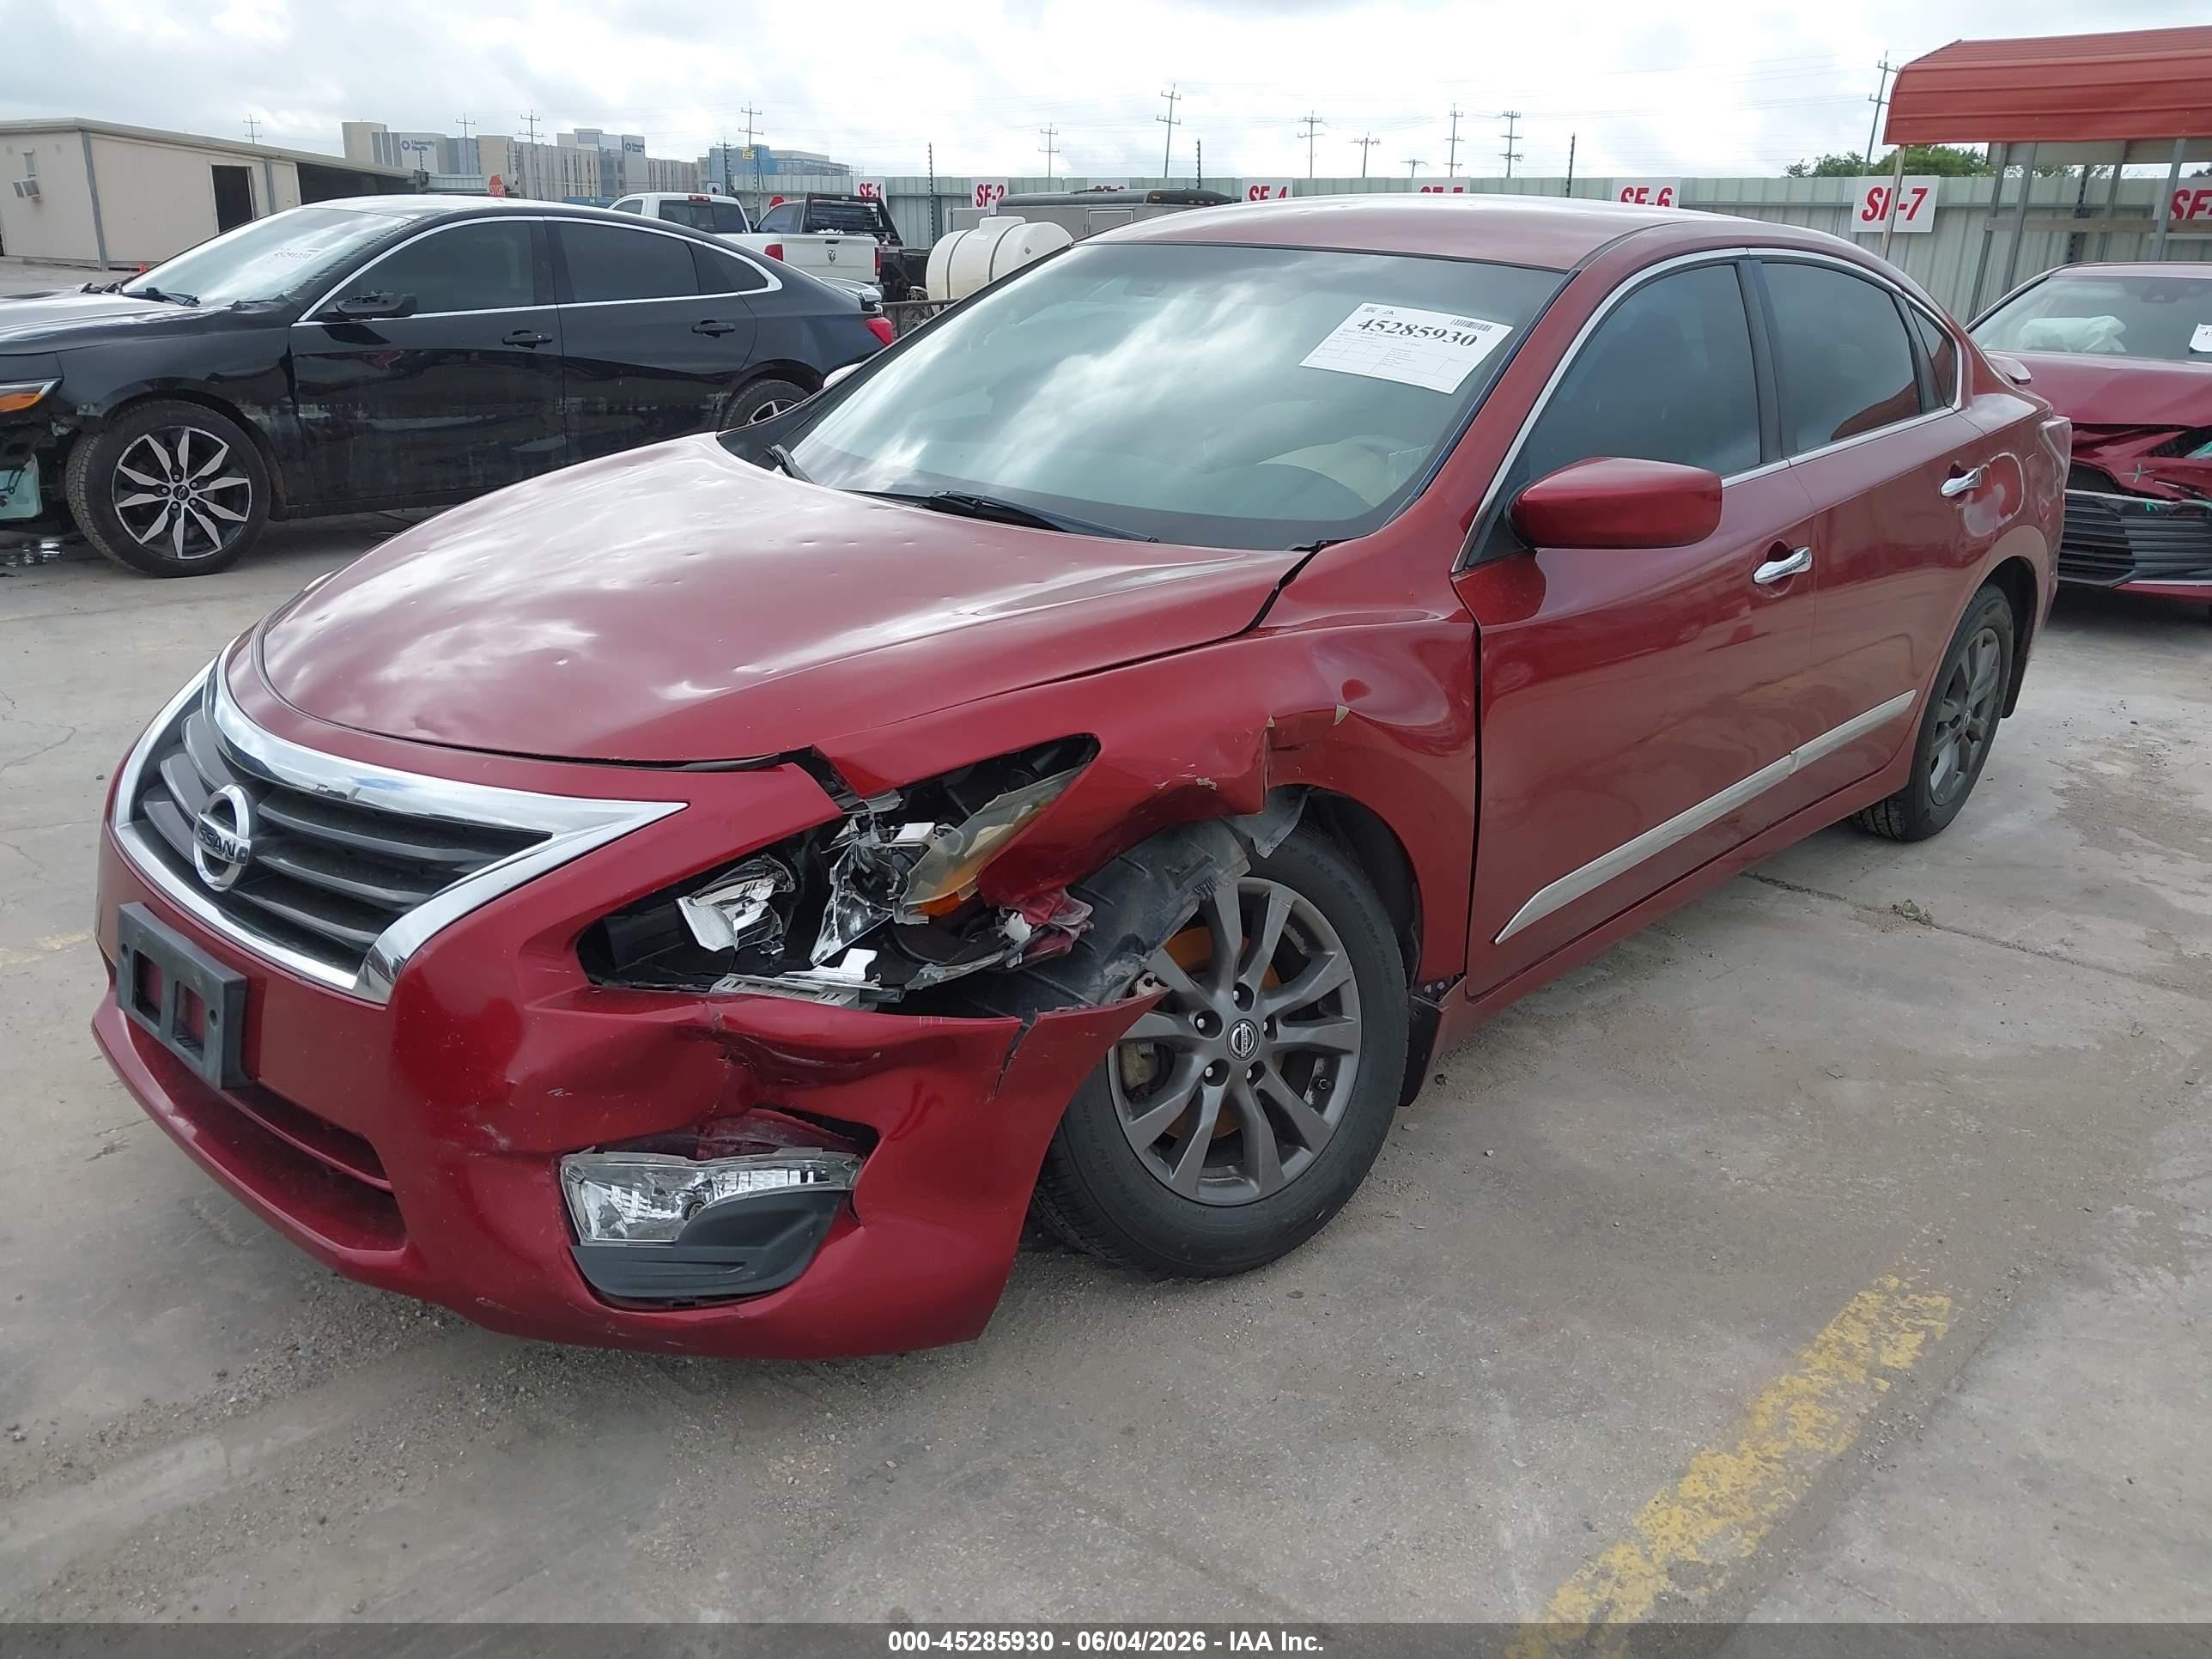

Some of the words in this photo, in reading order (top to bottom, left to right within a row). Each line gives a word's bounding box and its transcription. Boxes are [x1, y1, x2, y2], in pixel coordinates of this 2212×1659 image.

[489, 184, 503, 196] STOP
[975, 184, 1005, 208] SF-2
[1249, 185, 1288, 202] SF4
[1357, 318, 1478, 347] 45285930
[197, 826, 237, 860] SSAN
